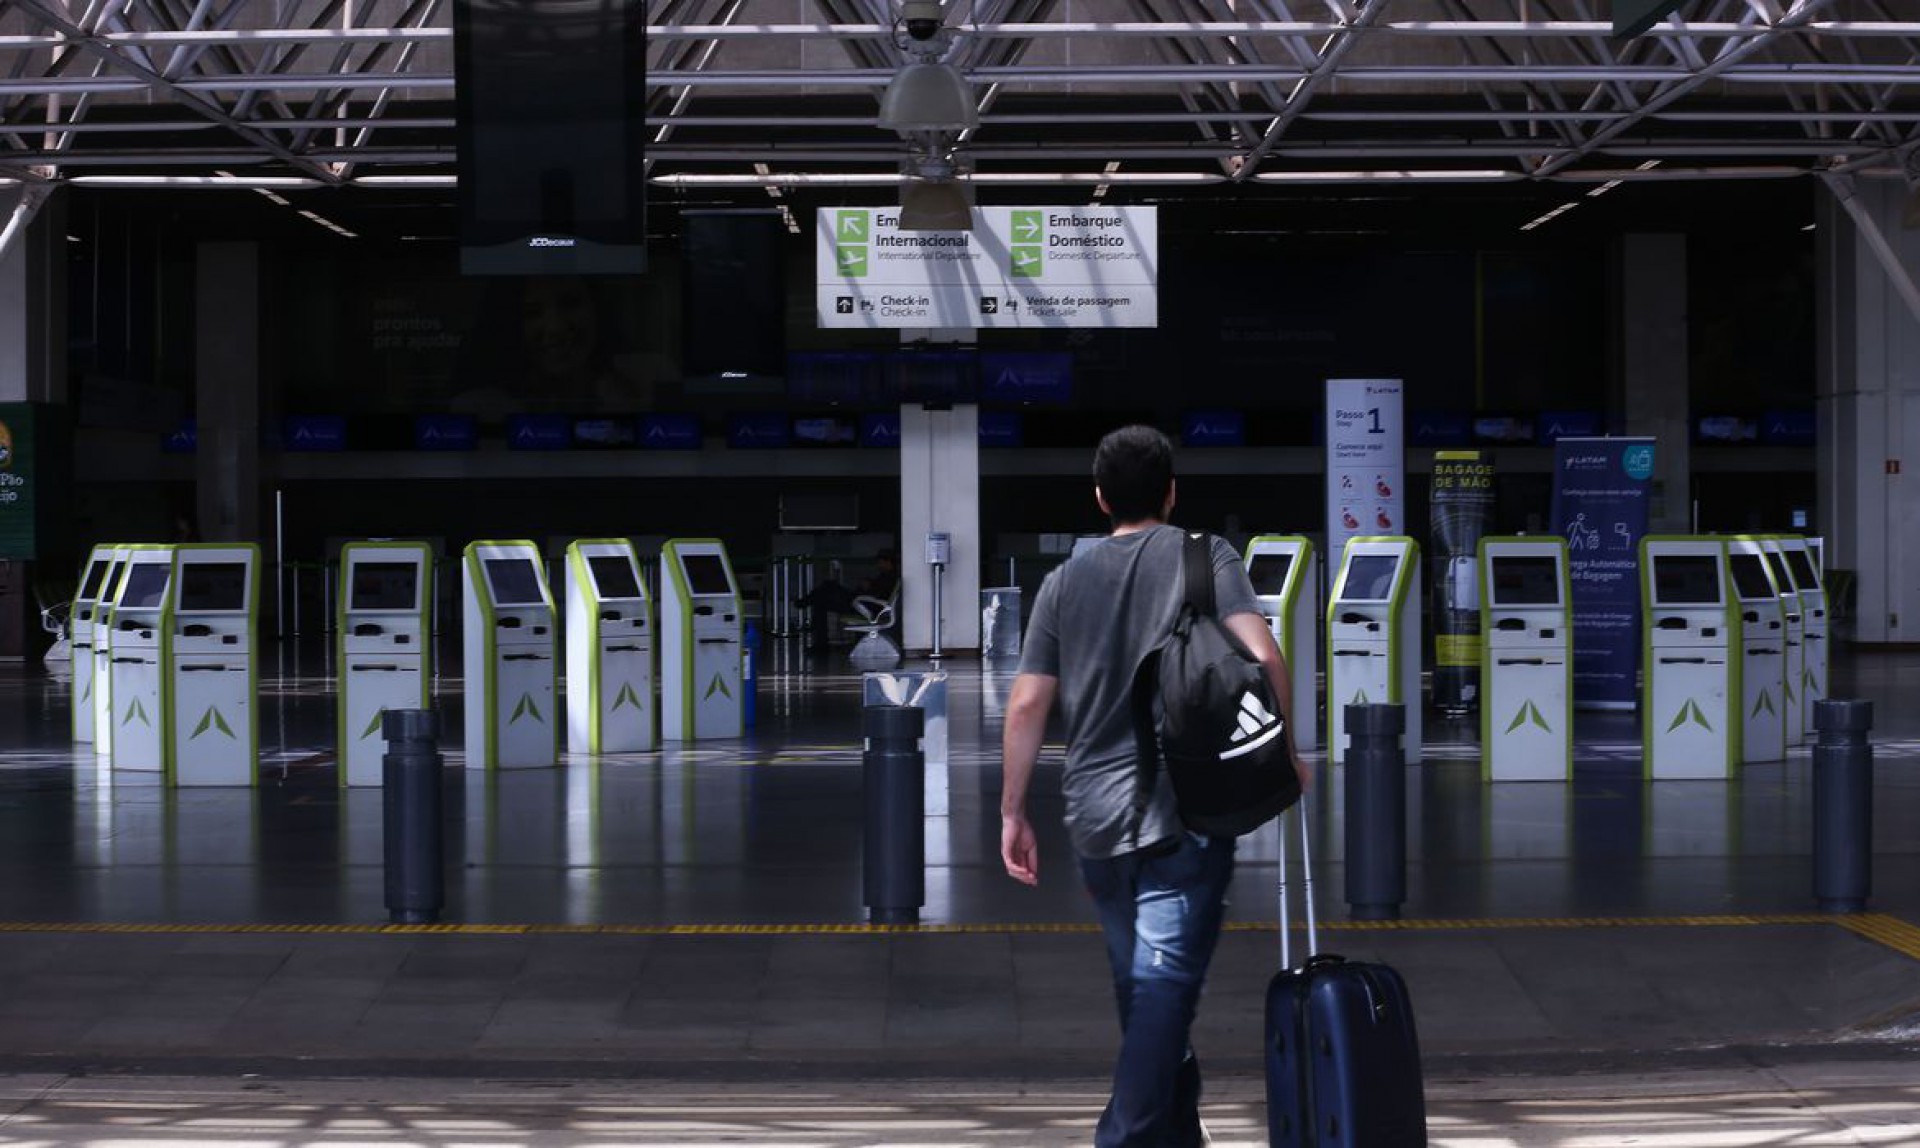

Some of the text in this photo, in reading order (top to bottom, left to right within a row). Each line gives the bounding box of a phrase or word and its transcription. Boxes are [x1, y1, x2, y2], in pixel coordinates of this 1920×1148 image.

[876, 214, 899, 227] Em
[1049, 213, 1122, 230] Embarque
[876, 233, 969, 247] Internacional
[1049, 234, 1124, 247] Doméstico
[1049, 250, 1093, 260] Domestic
[881, 295, 930, 306] Check-in
[1027, 296, 1130, 308] Venda de passagem
[881, 306, 927, 317] Check-in
[1027, 306, 1056, 316] Ticket
[1335, 408, 1386, 434] Passo 1
[1435, 476, 1491, 488] DE MÃO
